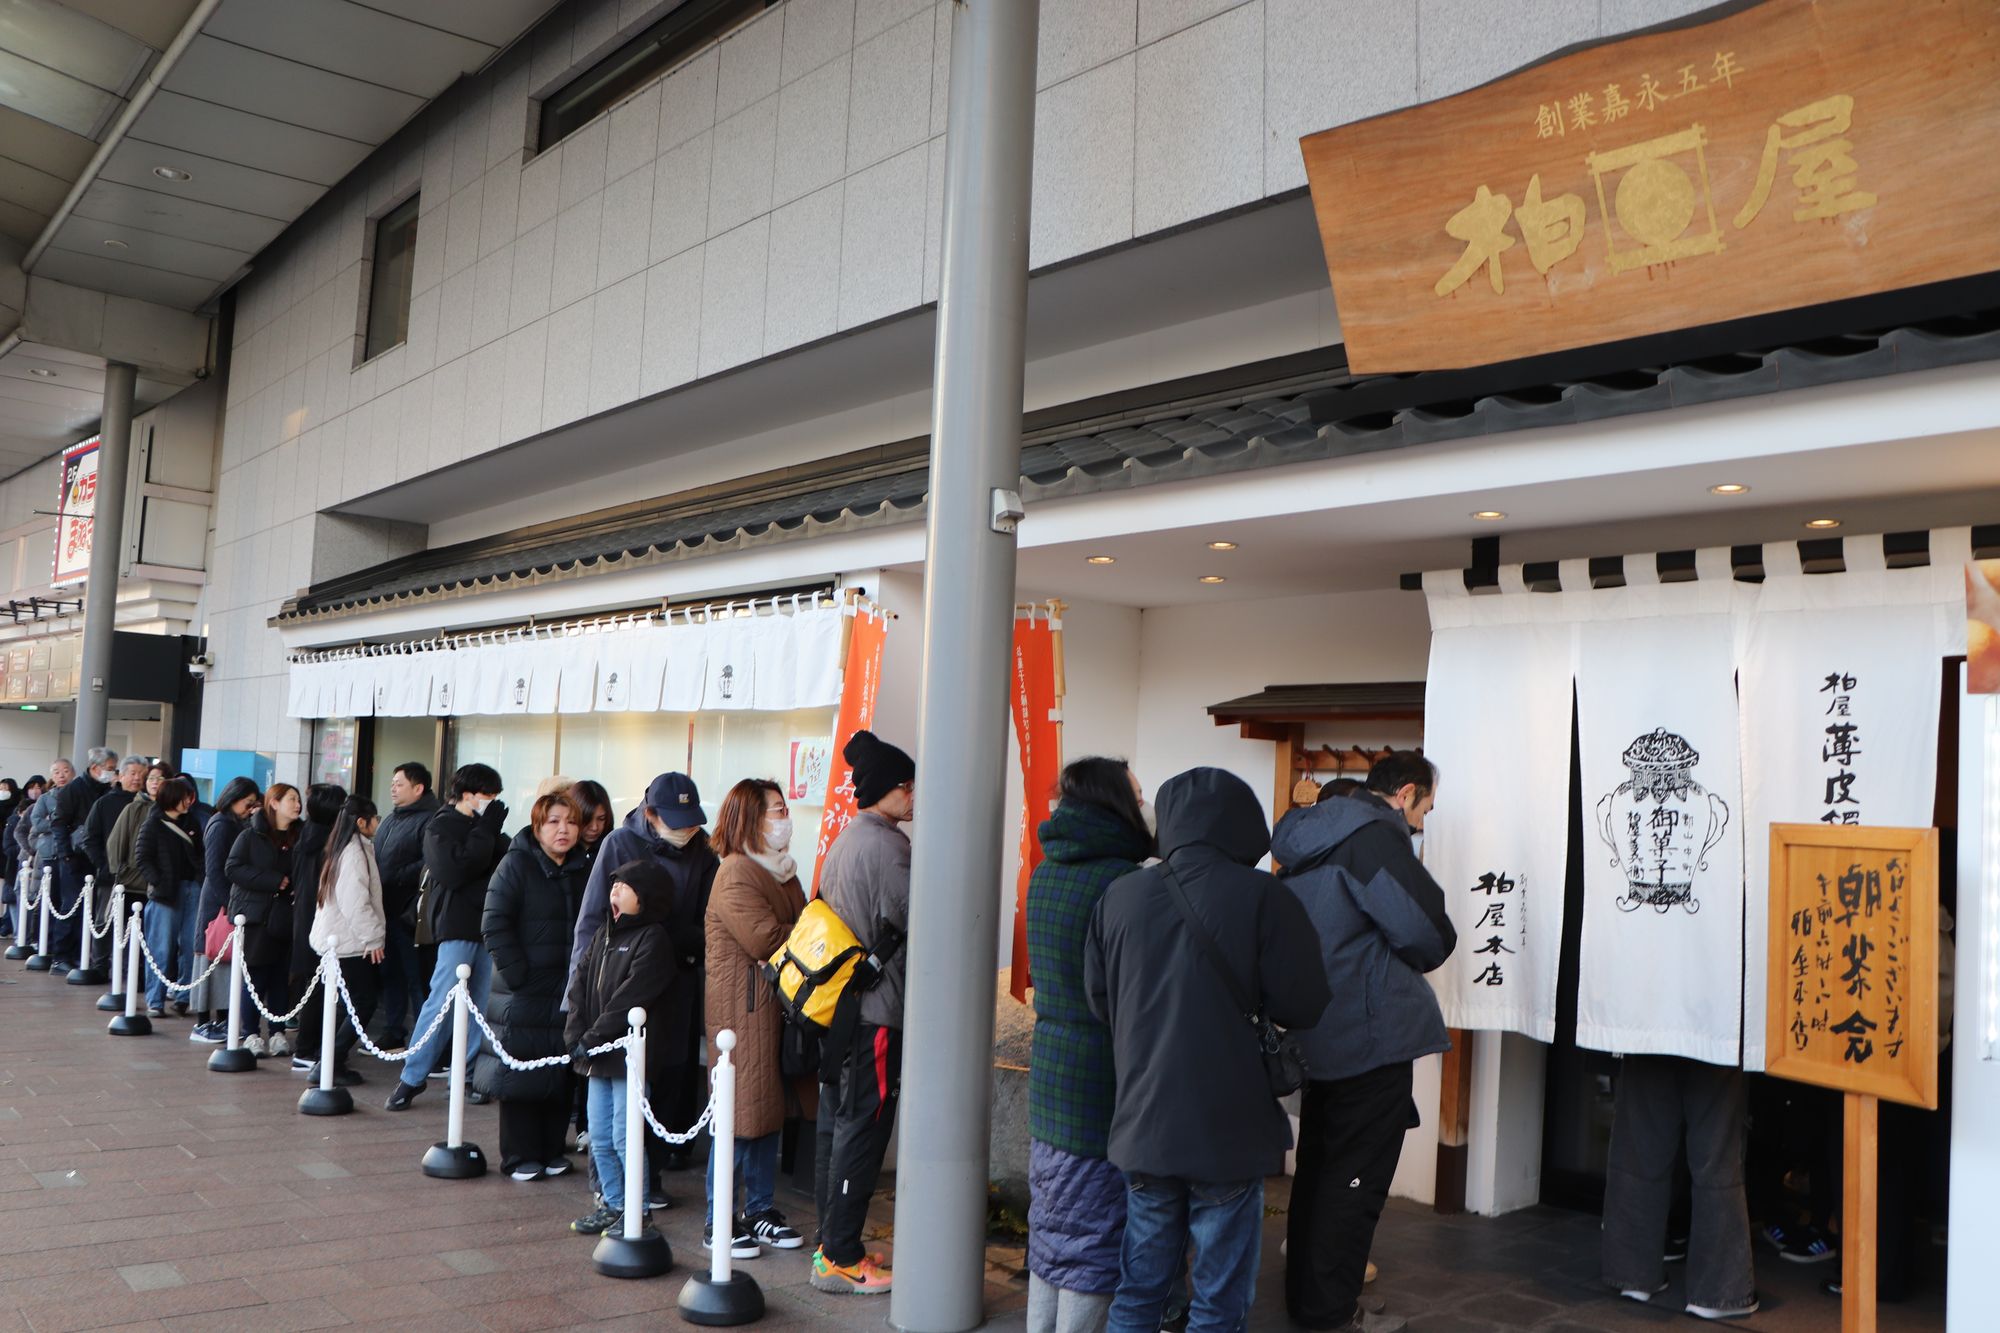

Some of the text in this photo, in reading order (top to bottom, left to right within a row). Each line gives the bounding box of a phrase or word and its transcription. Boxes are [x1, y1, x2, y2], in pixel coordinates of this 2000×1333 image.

[1535, 51, 1744, 139] 創業嘉永五年
[1646, 806, 1679, 887] 御菓子
[1470, 870, 1516, 986] 柏屋本店
[1790, 907, 1813, 1051] 柏屋本店
[1829, 864, 1882, 1064] 朝茶会
[1884, 857, 1909, 1059] おはようございます
